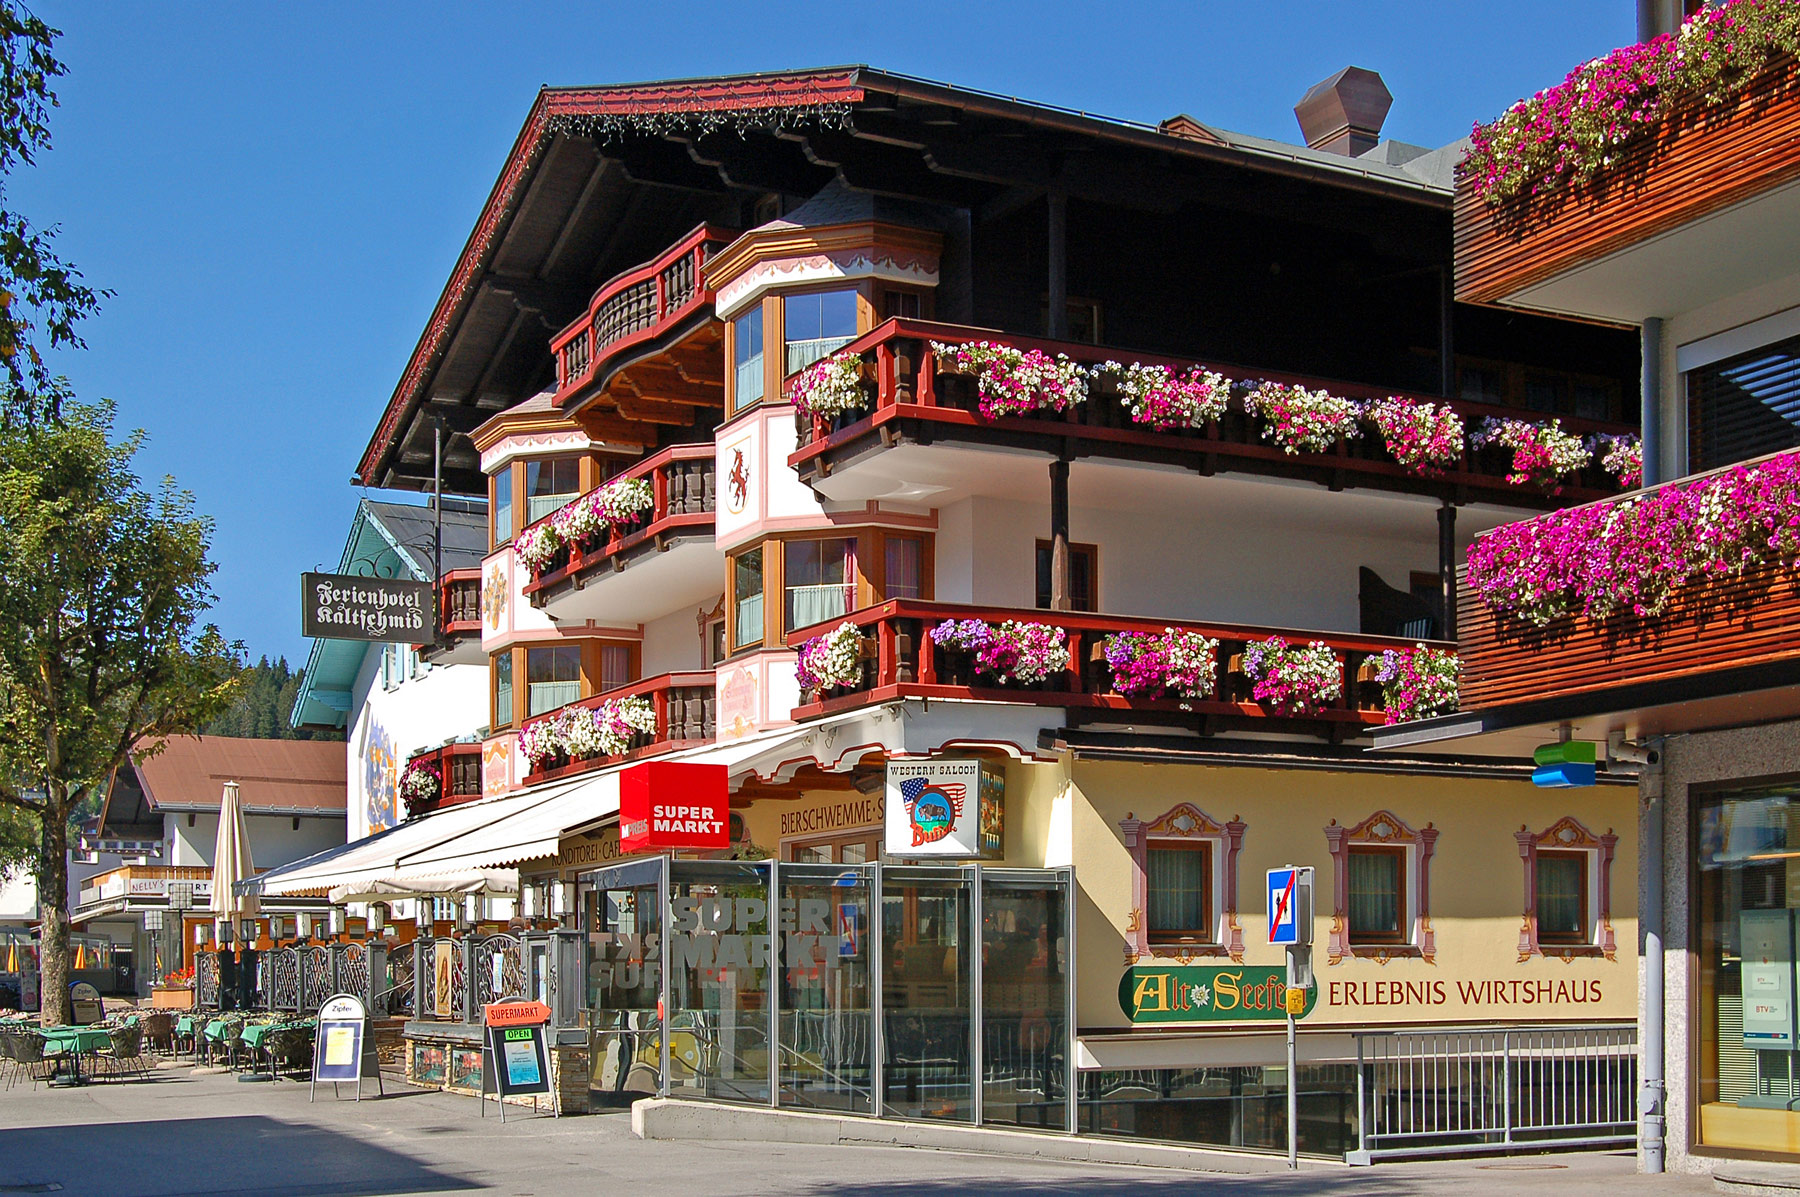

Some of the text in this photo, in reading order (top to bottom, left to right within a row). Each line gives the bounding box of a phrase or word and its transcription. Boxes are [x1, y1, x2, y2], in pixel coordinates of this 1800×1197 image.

[317, 580, 421, 610] Ferienhotel
[890, 765, 976, 776] WESTERN SALOON
[653, 805, 714, 820] SUPER
[781, 800, 872, 834] BIERSCHWEMME
[653, 819, 724, 834] MARKT
[551, 844, 598, 867] KONDITOREI
[132, 879, 164, 892] NELLY'S
[672, 897, 830, 932] SUPER
[672, 934, 840, 968] MARKT
[1133, 973, 1191, 1018] Alt
[1213, 971, 1307, 1012] Seefe
[1328, 981, 1447, 1006] ERLEBNIS
[1456, 979, 1603, 1005] WIRTSHAUS
[332, 1005, 352, 1013] Zipfer
[490, 1006, 539, 1020] SUPERMARKT
[1756, 1005, 1769, 1013] BTV
[508, 1029, 530, 1039] OPEN
